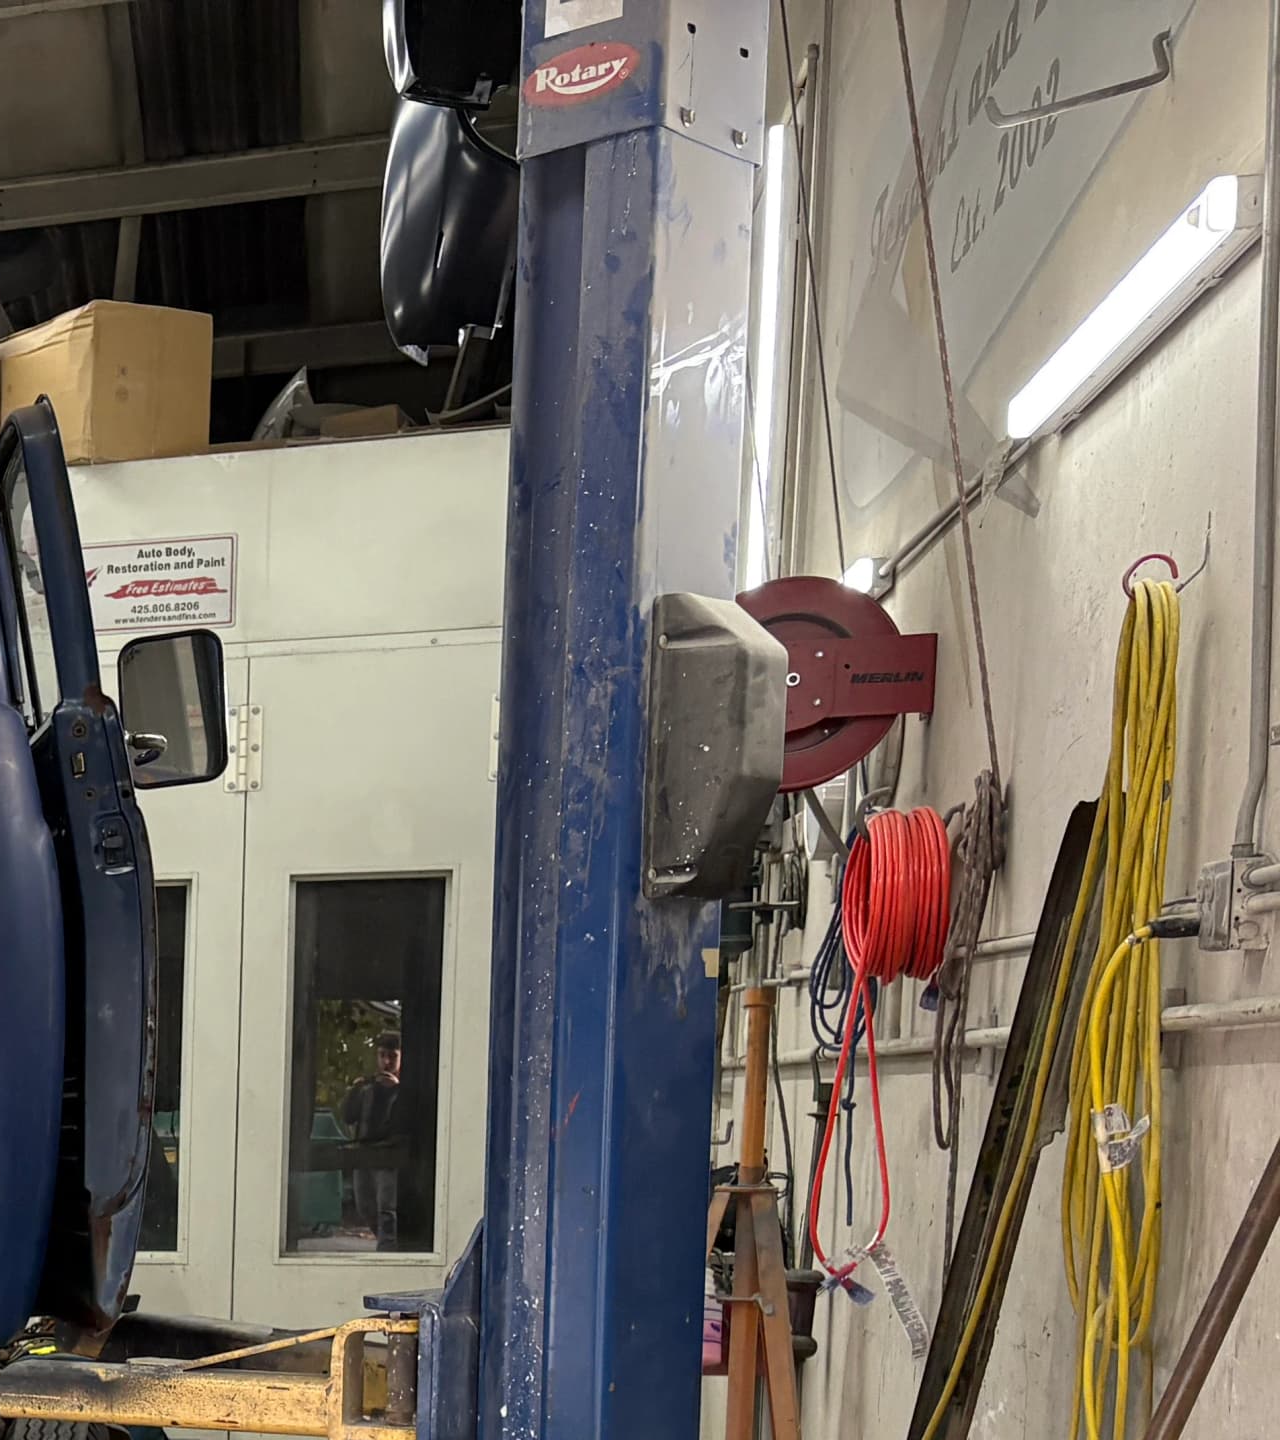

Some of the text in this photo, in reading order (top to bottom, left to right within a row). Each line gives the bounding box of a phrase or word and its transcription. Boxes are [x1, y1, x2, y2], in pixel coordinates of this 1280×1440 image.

[535, 56, 628, 95] Rotary
[137, 546, 196, 559] Auto Body,
[107, 557, 225, 575] Restoration and Paint
[125, 580, 206, 595] Free Estimates
[851, 672, 924, 684] MERLIN
